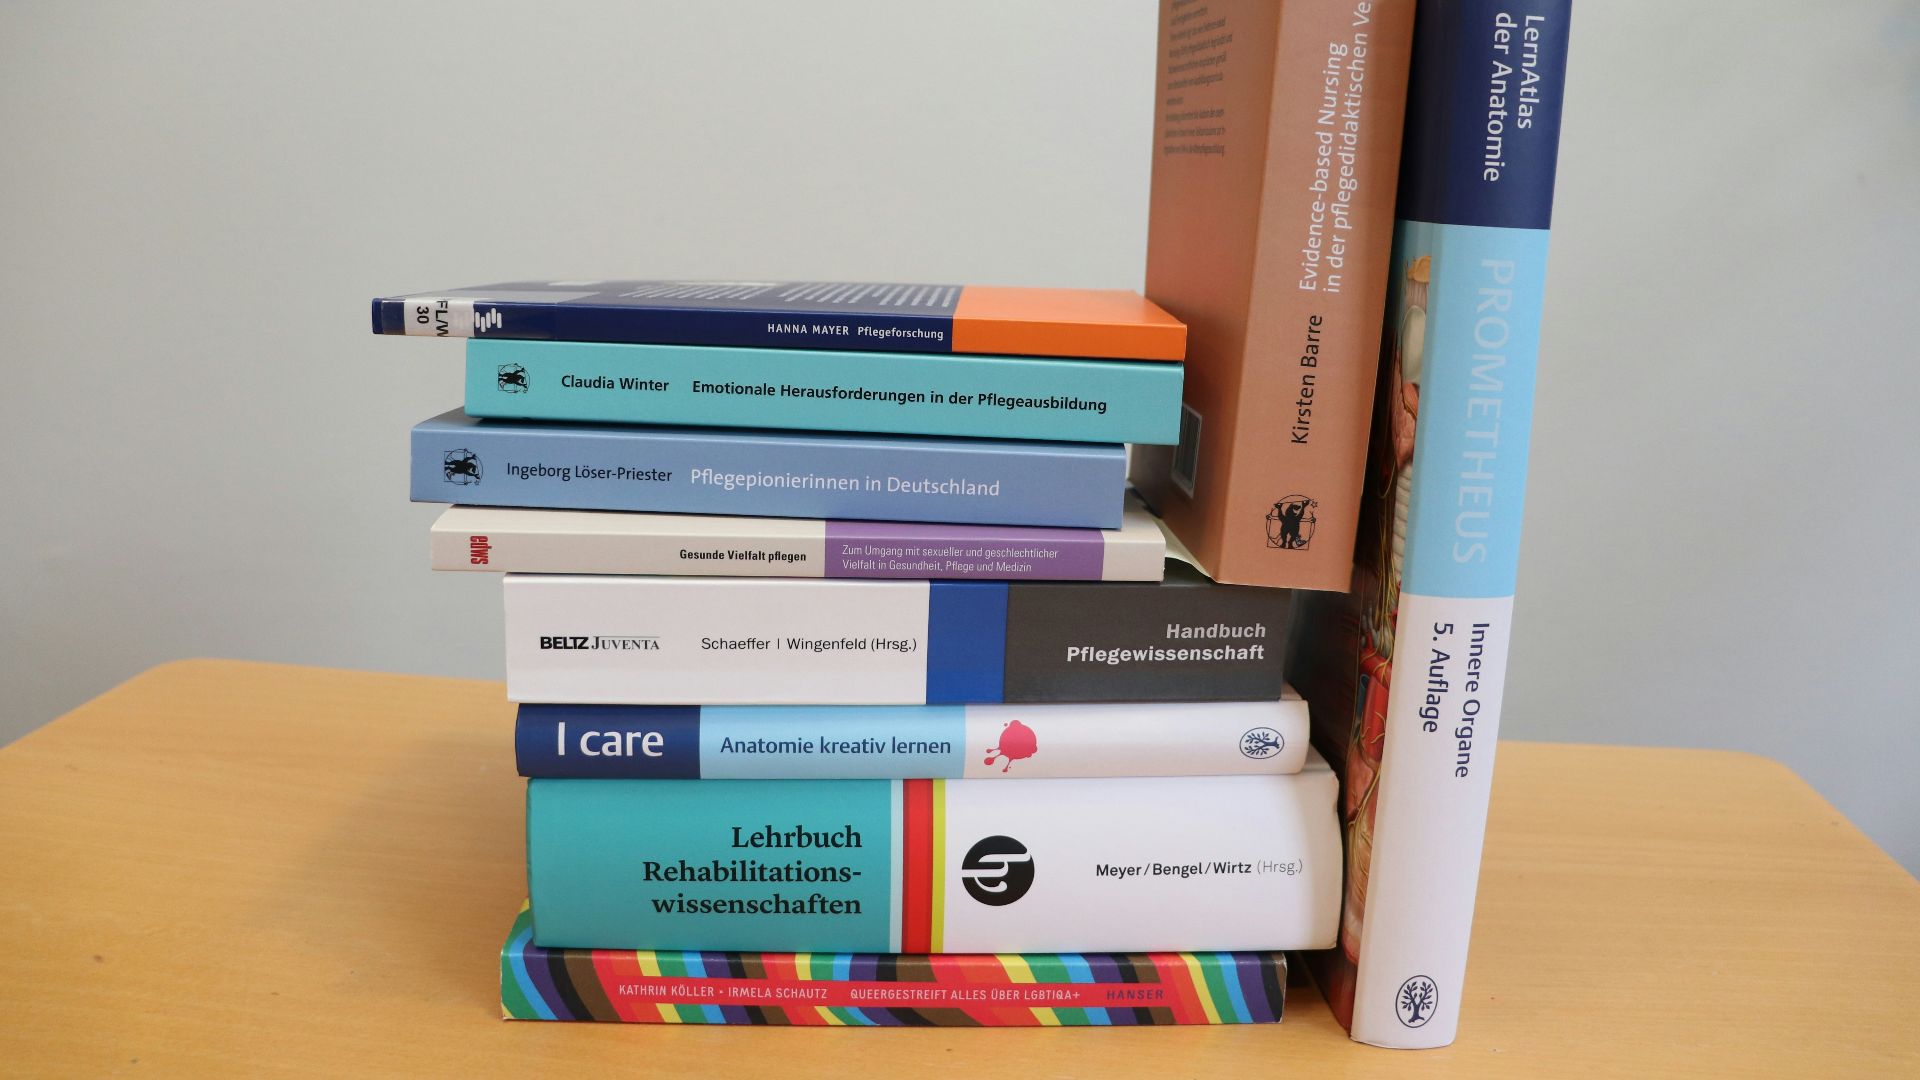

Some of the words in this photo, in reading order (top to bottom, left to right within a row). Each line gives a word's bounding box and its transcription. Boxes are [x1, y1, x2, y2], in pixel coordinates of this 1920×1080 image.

[1352, 0, 1373, 26] Ve
[1494, 12, 1518, 55] der
[1517, 15, 1545, 129] LernAtlas
[1330, 33, 1368, 229] pflegedidaktischen
[1483, 60, 1513, 182] Anatomie
[1299, 131, 1334, 291] Evidence-based
[1318, 42, 1348, 125] Nursing
[1325, 235, 1346, 268] der
[1323, 275, 1342, 293] in
[416, 305, 430, 325] 30
[767, 323, 808, 335] HANNA
[812, 324, 849, 336] MAYER
[857, 326, 944, 342] Pflegeforschung
[1301, 315, 1323, 368] Barre
[561, 374, 615, 391] Claudia
[619, 376, 670, 392] Winter
[692, 380, 776, 397] Emotionale
[780, 384, 926, 406] Herausforderungen
[930, 390, 945, 404] in
[948, 390, 974, 406] der
[978, 392, 1107, 414] Pflegeausbildung
[1291, 374, 1316, 444] Kirsten
[1452, 258, 1516, 564] PROMETHEUS
[506, 462, 571, 482] Ingeborg
[575, 464, 673, 483] Löser-Priester
[691, 468, 860, 491] Pflegepionierinnen
[865, 474, 882, 492] in
[887, 476, 1000, 496] Deutschland
[679, 549, 727, 561] Gesunde
[727, 549, 766, 562] Vielfalt
[768, 550, 807, 563] pflegen
[842, 545, 862, 556] Zum
[865, 545, 903, 559] Umgang
[905, 546, 920, 557] mit
[922, 546, 963, 558] sexueller
[965, 548, 983, 558] und
[985, 548, 1059, 560] geschlechtlicher
[842, 559, 876, 570] Vielfalt
[878, 560, 887, 570] in
[889, 560, 943, 572] Gesundheit,
[946, 561, 974, 573] Pflege
[976, 561, 994, 572] und
[996, 562, 1032, 573] Medizin
[1166, 623, 1266, 639] Handbuch
[1432, 622, 1454, 642] 5.
[540, 636, 589, 650] BELTZ
[591, 636, 660, 651] JUVENTA
[701, 636, 770, 650] Schaeffer
[786, 636, 867, 653] Wingenfeld
[870, 636, 917, 653] (Hrsg.)
[1066, 645, 1265, 665] Pflegewissenschaft
[1465, 623, 1490, 693] Innere
[1419, 648, 1451, 733] Auflage
[557, 721, 566, 756] I
[579, 730, 664, 758] care
[720, 736, 814, 754] Anatomie
[819, 736, 885, 755] kreativ
[891, 736, 951, 755] lernen
[1455, 699, 1481, 778] Organe
[731, 825, 863, 848] Lehrbuch
[643, 860, 862, 882] Rehabilitations-
[1256, 859, 1304, 876] (Hrsg.)
[651, 893, 862, 914] wissenschaften
[619, 984, 667, 997] KATHRIN
[671, 983, 715, 998] KÖLLER
[728, 986, 771, 999] IRMELA
[776, 987, 828, 1000] SCHAUTZ
[850, 988, 948, 1001] QUEERGESTREIFT
[950, 989, 987, 1001] ALLES
[991, 987, 1020, 1001] ÜBER
[1024, 989, 1081, 1001] LGBTIQA+
[1106, 989, 1164, 1000] HANSER
